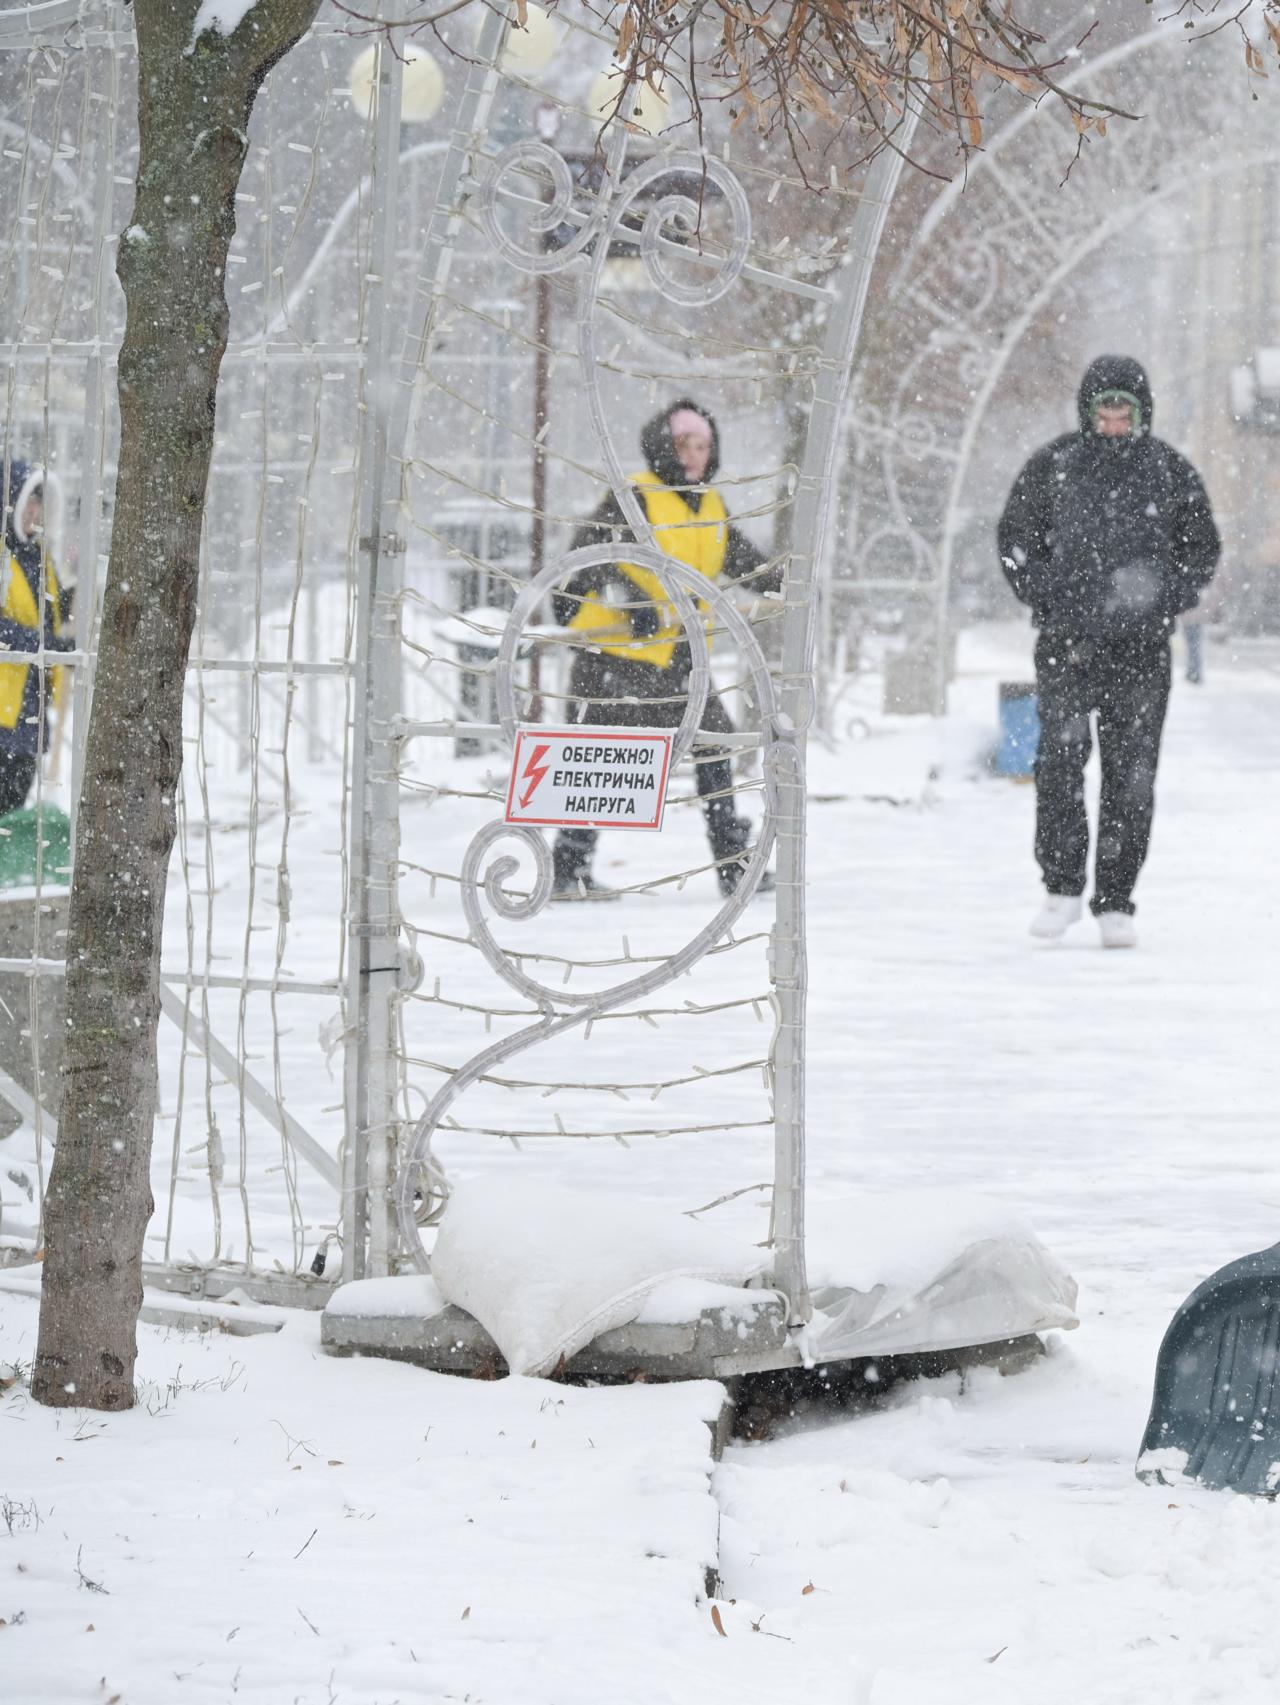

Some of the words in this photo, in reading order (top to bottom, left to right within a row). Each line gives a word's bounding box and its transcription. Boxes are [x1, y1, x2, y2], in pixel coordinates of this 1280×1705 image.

[562, 746, 654, 764] ОБЕРЕЖНО!
[553, 771, 655, 789] ЕЛЕКТРИЧНА
[565, 796, 635, 814] НАПРУГА
